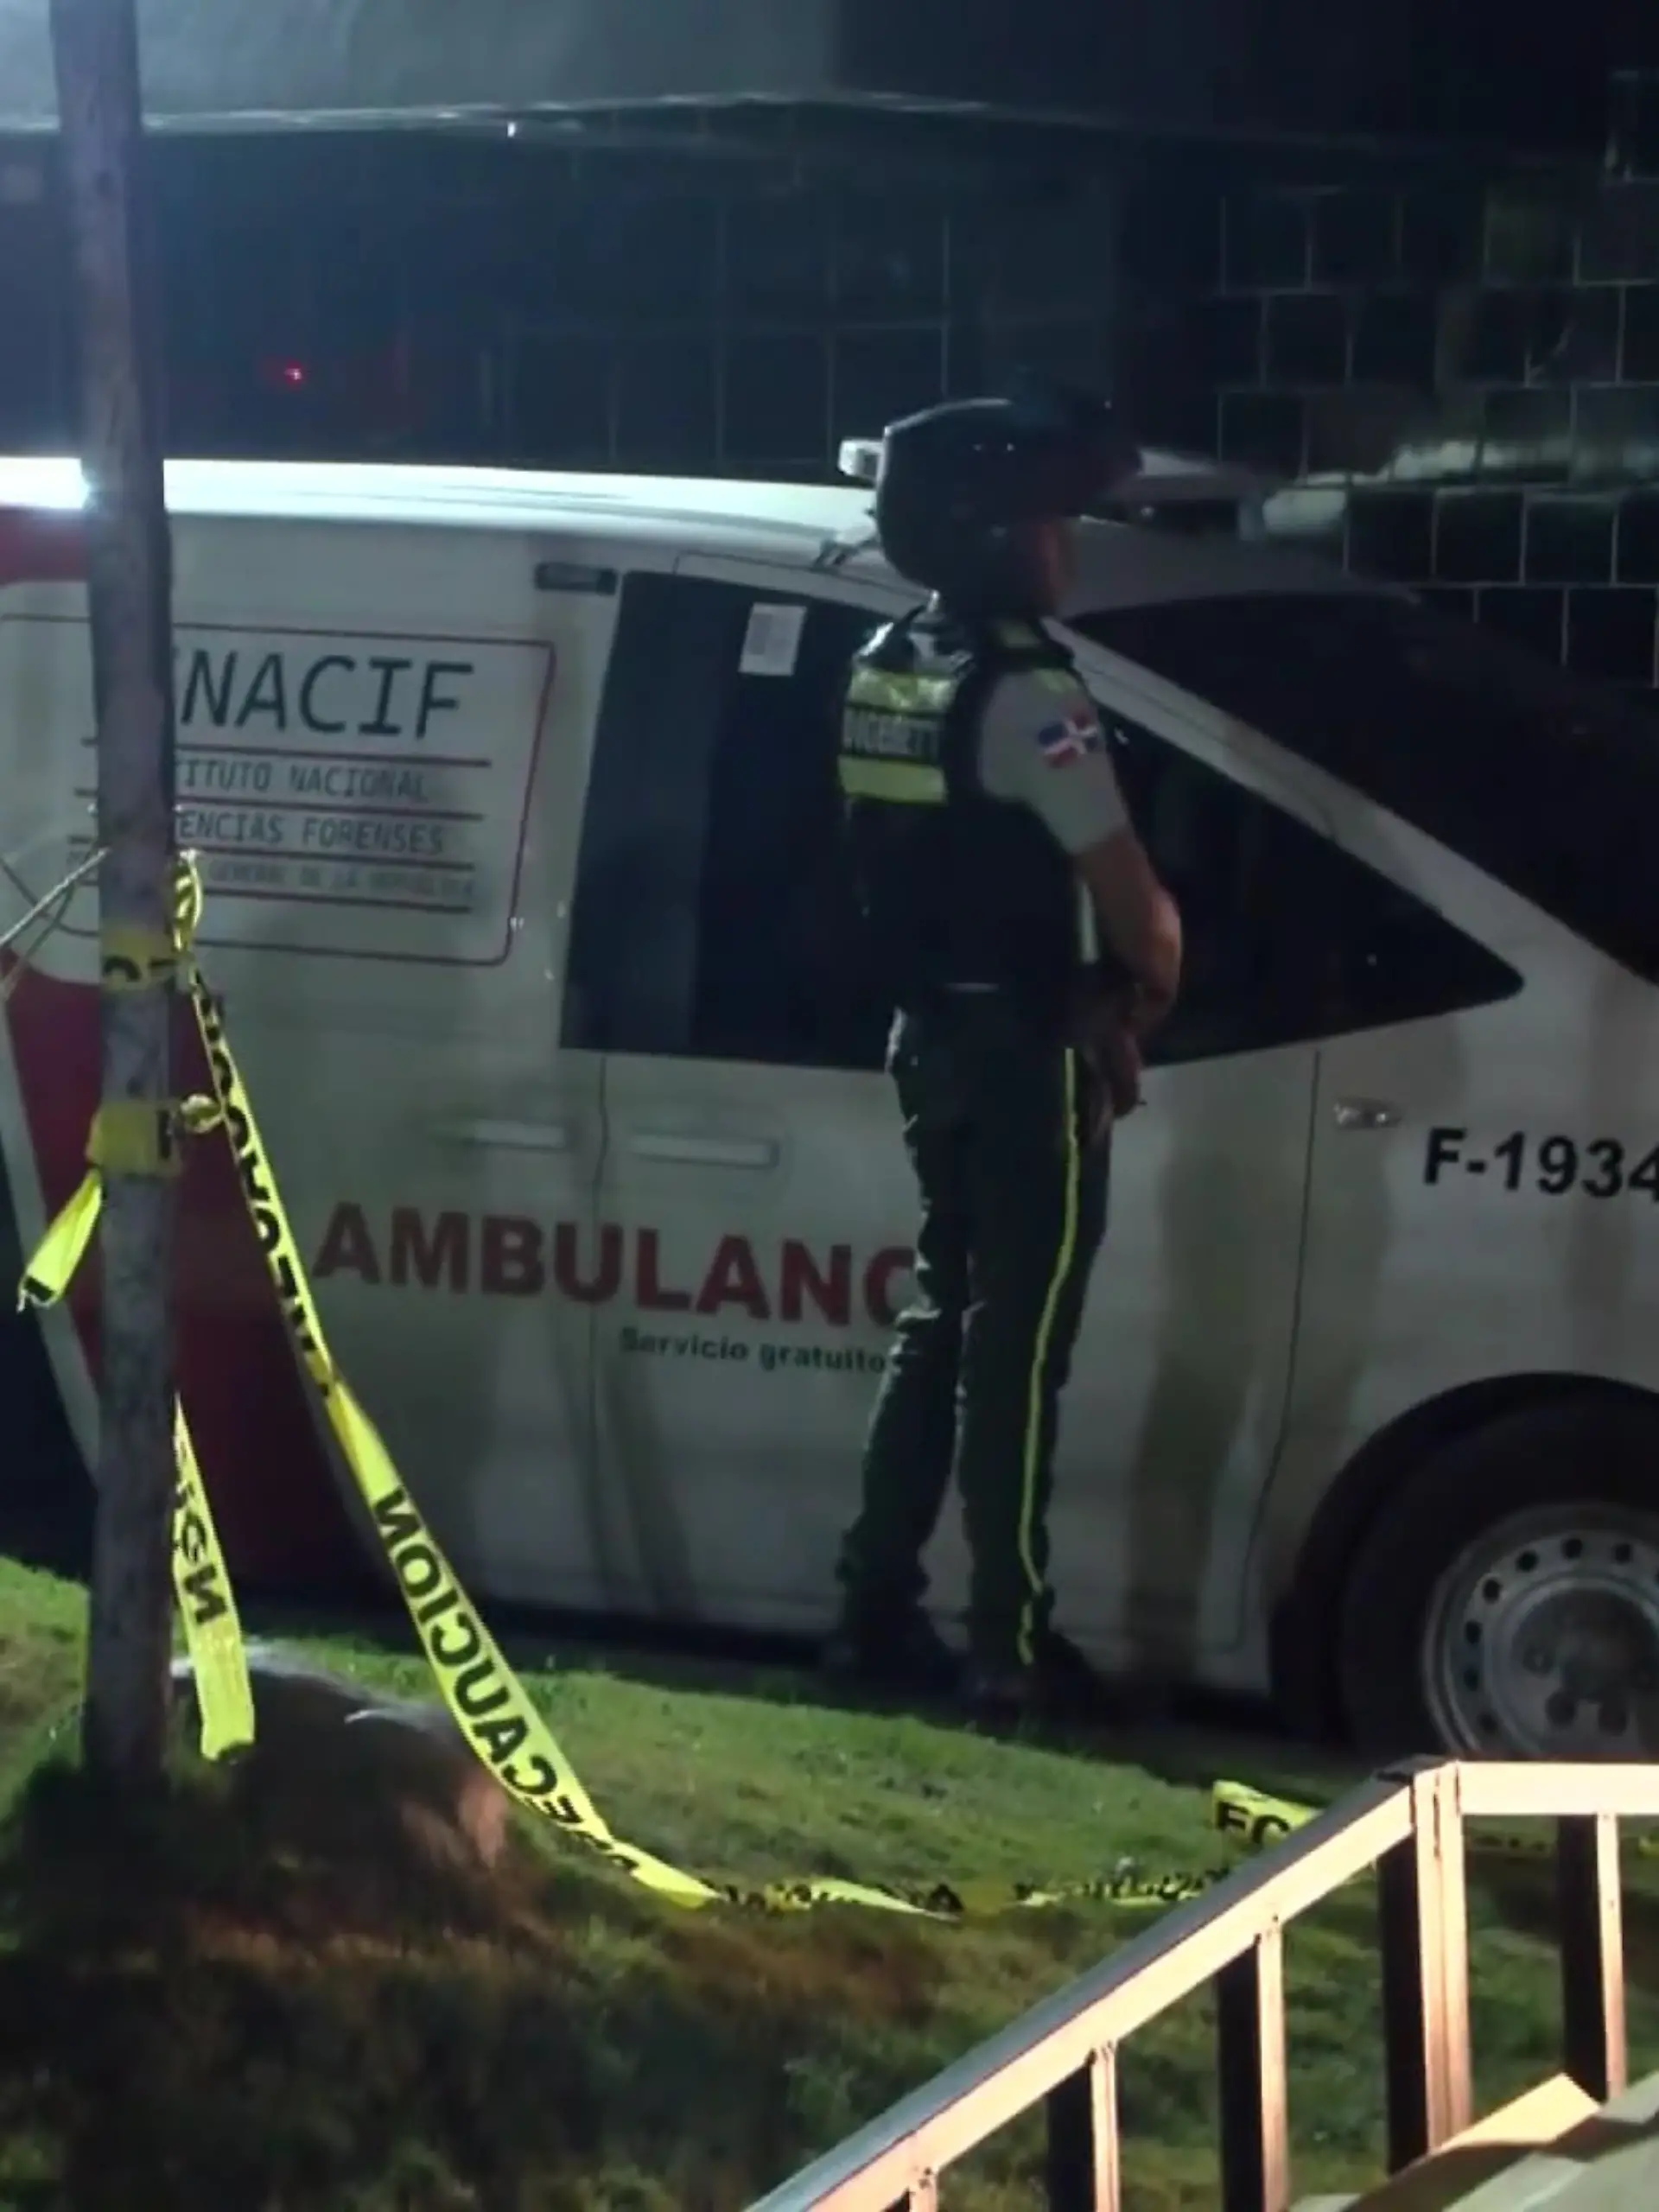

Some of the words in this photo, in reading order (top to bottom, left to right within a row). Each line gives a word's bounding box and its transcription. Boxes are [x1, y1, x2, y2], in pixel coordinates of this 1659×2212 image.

[174, 645, 474, 740] NACIF
[176, 759, 273, 791] ITUTO
[289, 764, 429, 803] NACIONAL
[176, 809, 283, 844] ENCIAS
[302, 817, 444, 855] FORENSES
[312, 1200, 918, 1328] AMBULANC
[619, 1324, 749, 1361] Servicio
[759, 1341, 887, 1374] gratuito
